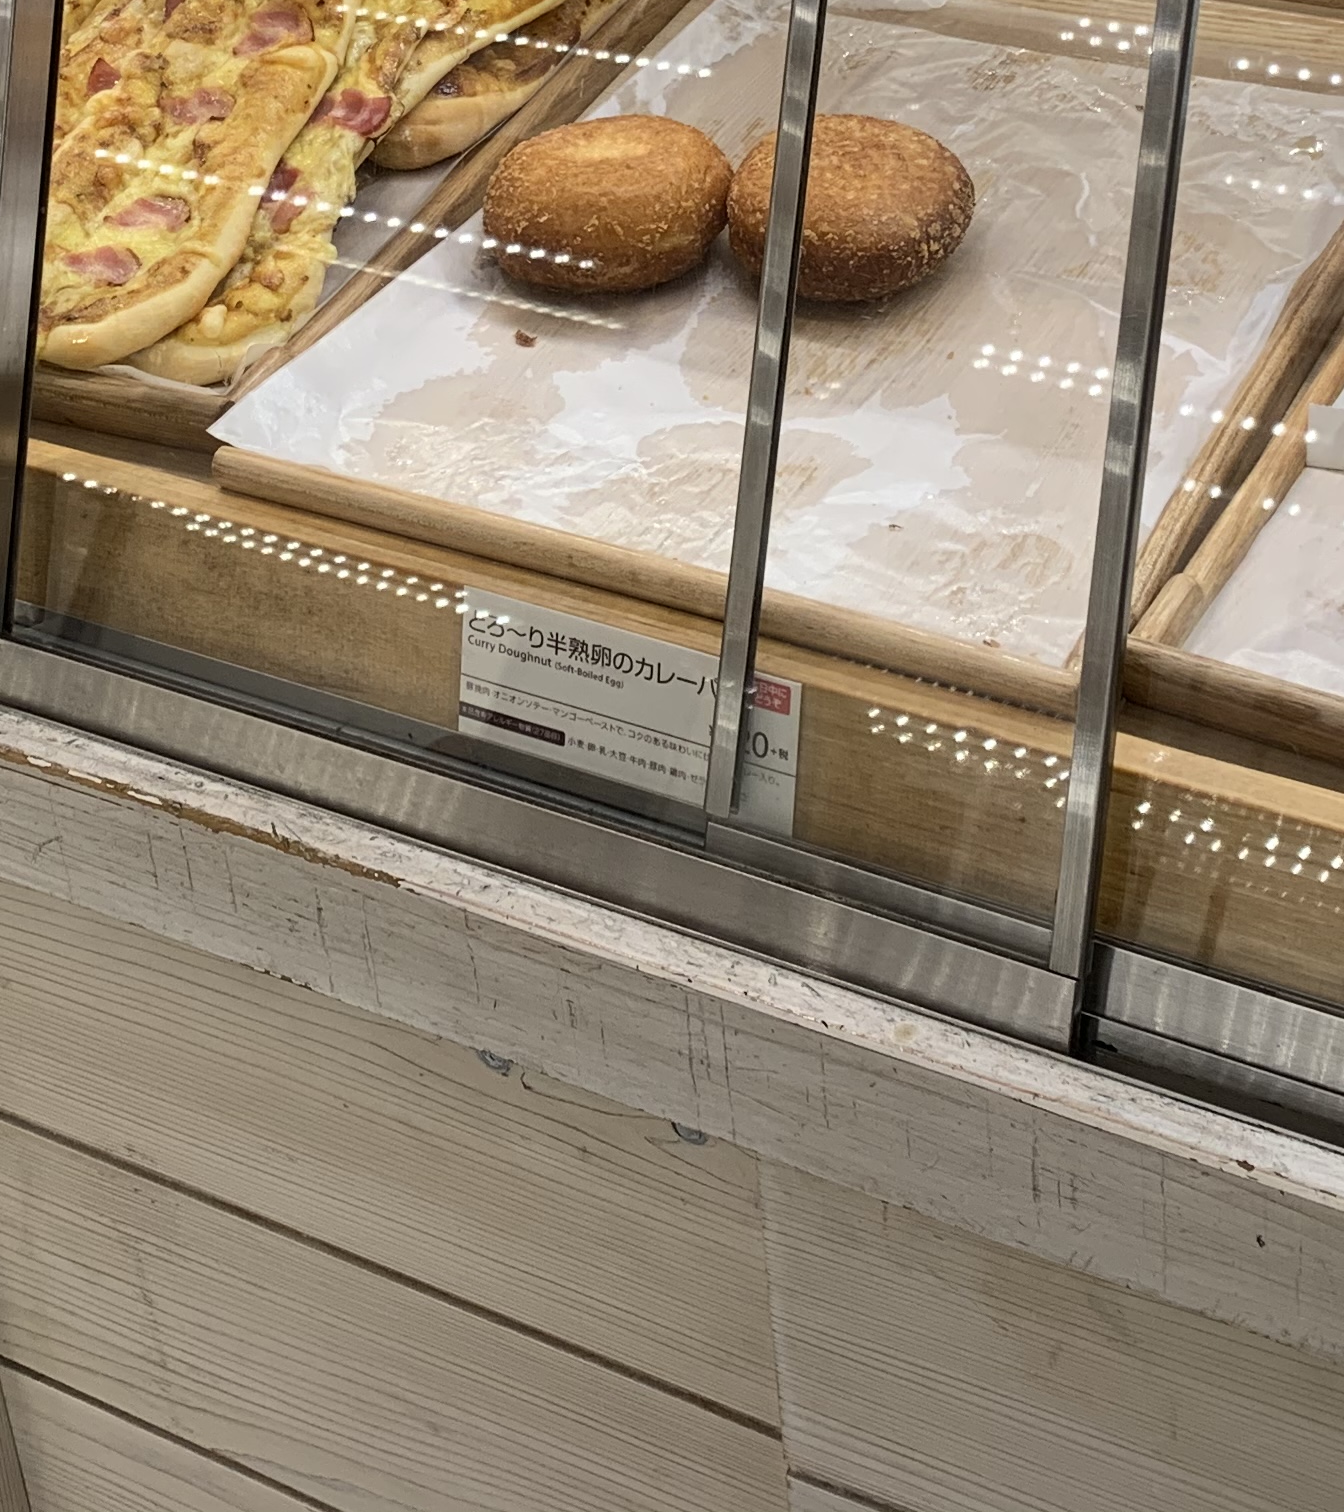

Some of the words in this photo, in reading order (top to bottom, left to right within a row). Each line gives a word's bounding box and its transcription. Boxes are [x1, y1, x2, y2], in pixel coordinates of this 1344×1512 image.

[467, 634, 497, 654] Curry
[497, 643, 553, 669] Doughnut
[554, 662, 605, 684] (Soft-Boiled
[604, 675, 626, 690] Egg)
